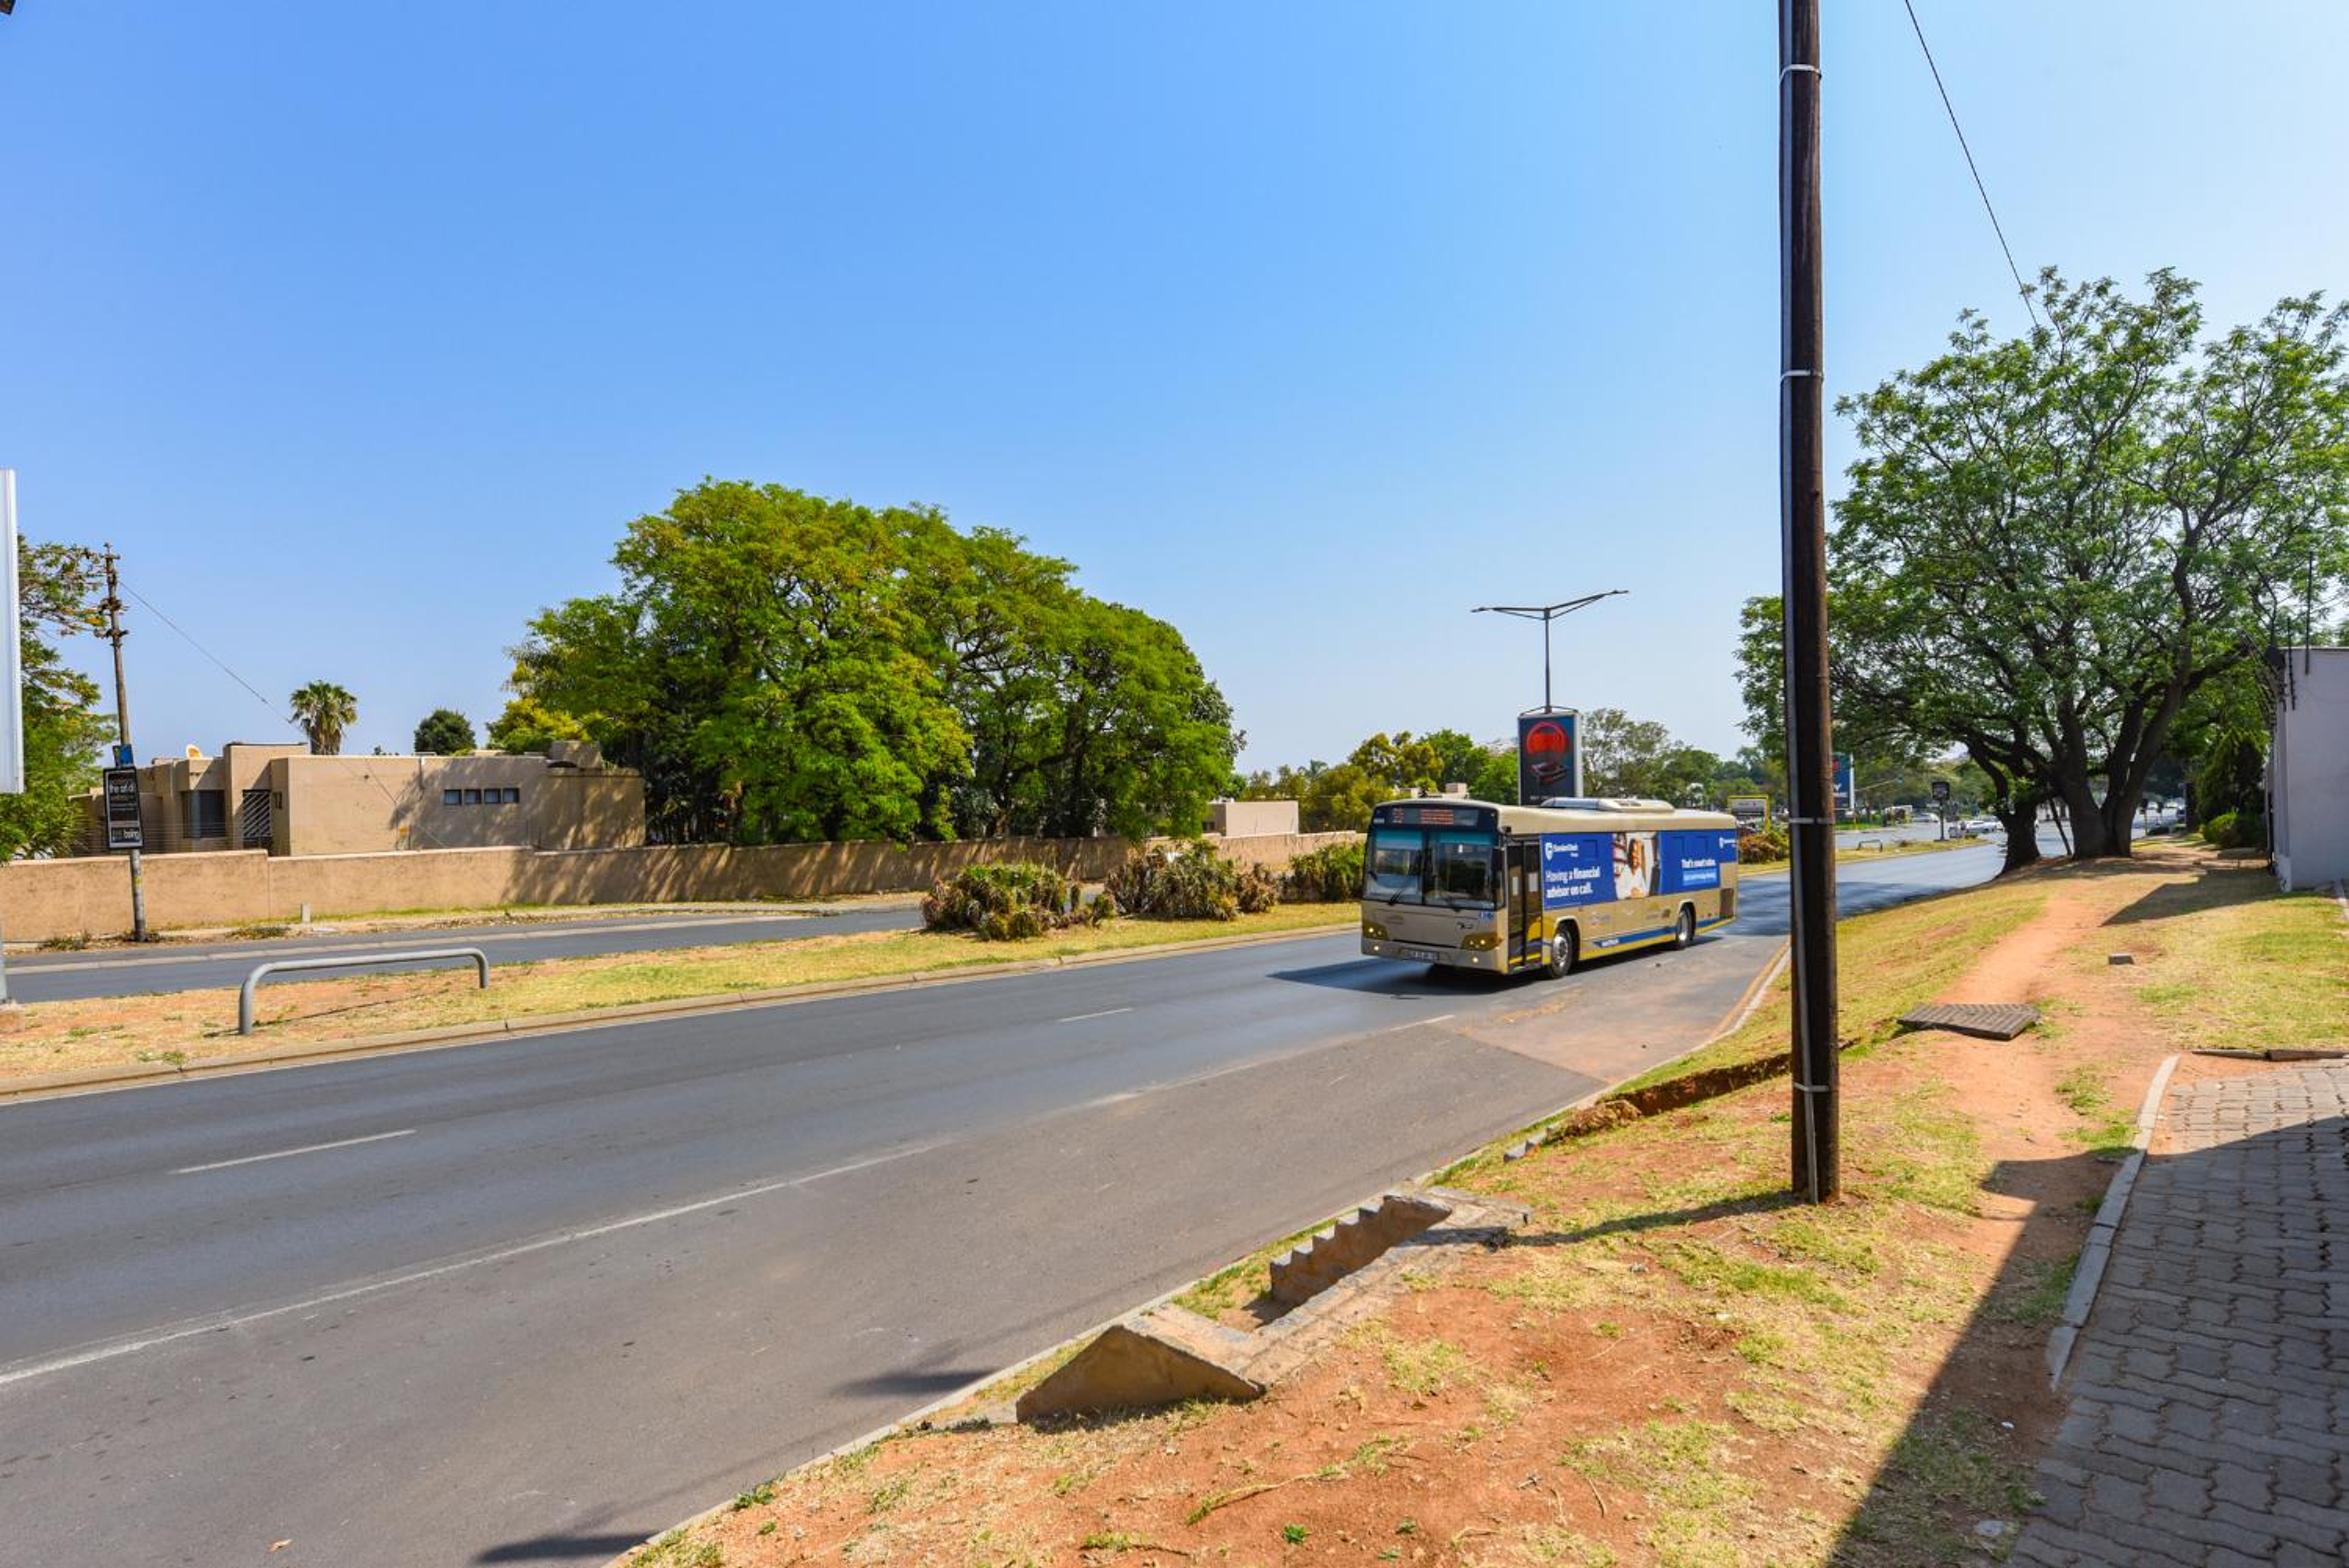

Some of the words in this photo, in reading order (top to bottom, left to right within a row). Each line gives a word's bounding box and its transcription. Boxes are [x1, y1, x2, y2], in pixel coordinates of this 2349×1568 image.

[1573, 865, 1600, 879] financial
[1570, 886, 1579, 896] on
[1579, 882, 1593, 895] call.
